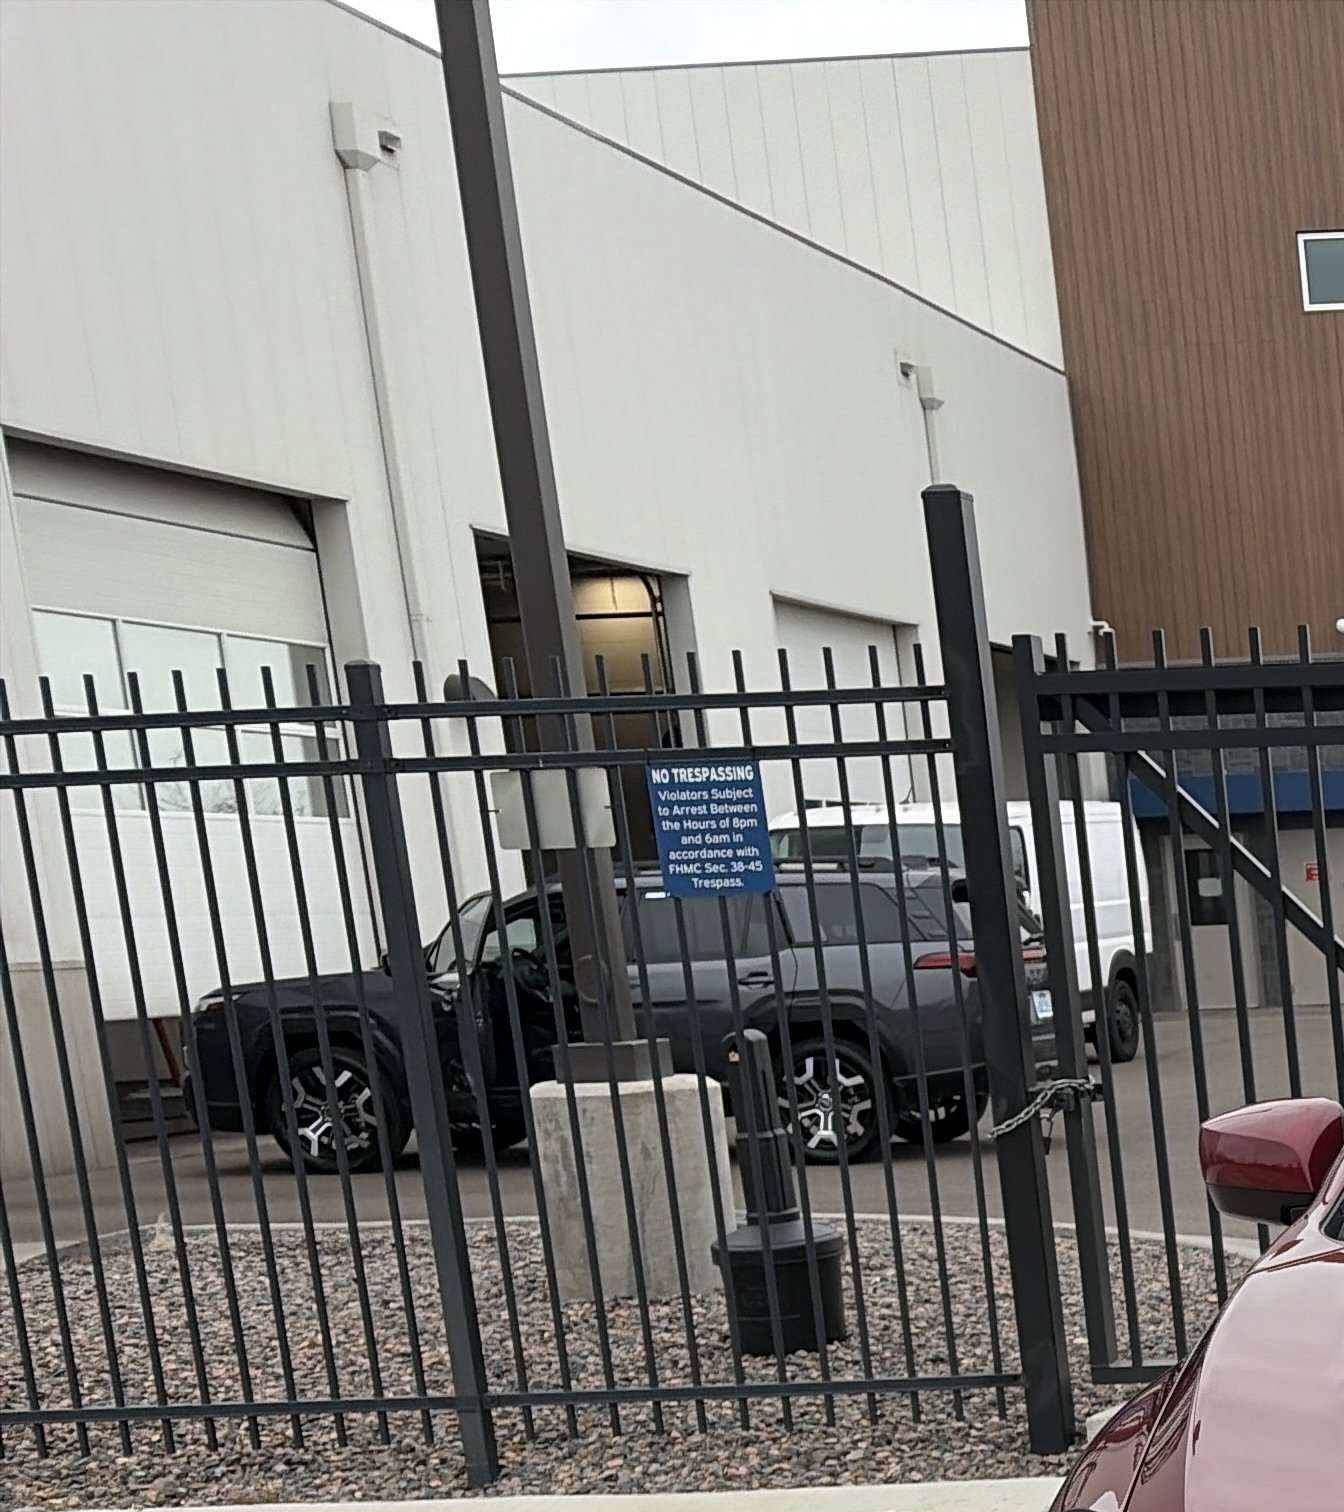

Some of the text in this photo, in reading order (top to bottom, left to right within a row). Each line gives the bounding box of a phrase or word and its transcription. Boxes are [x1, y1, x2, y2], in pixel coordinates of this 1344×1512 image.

[652, 765, 754, 784] NO TRESPASSING
[658, 787, 753, 801] Violators Subject
[658, 803, 758, 816] to Arrest Between
[662, 817, 758, 831] the Hours of 8pm
[681, 832, 743, 845] and 6am in
[669, 847, 759, 860] accordance with
[668, 860, 763, 874] FHMC Sec. 38-45
[691, 877, 744, 890] Trespass.
